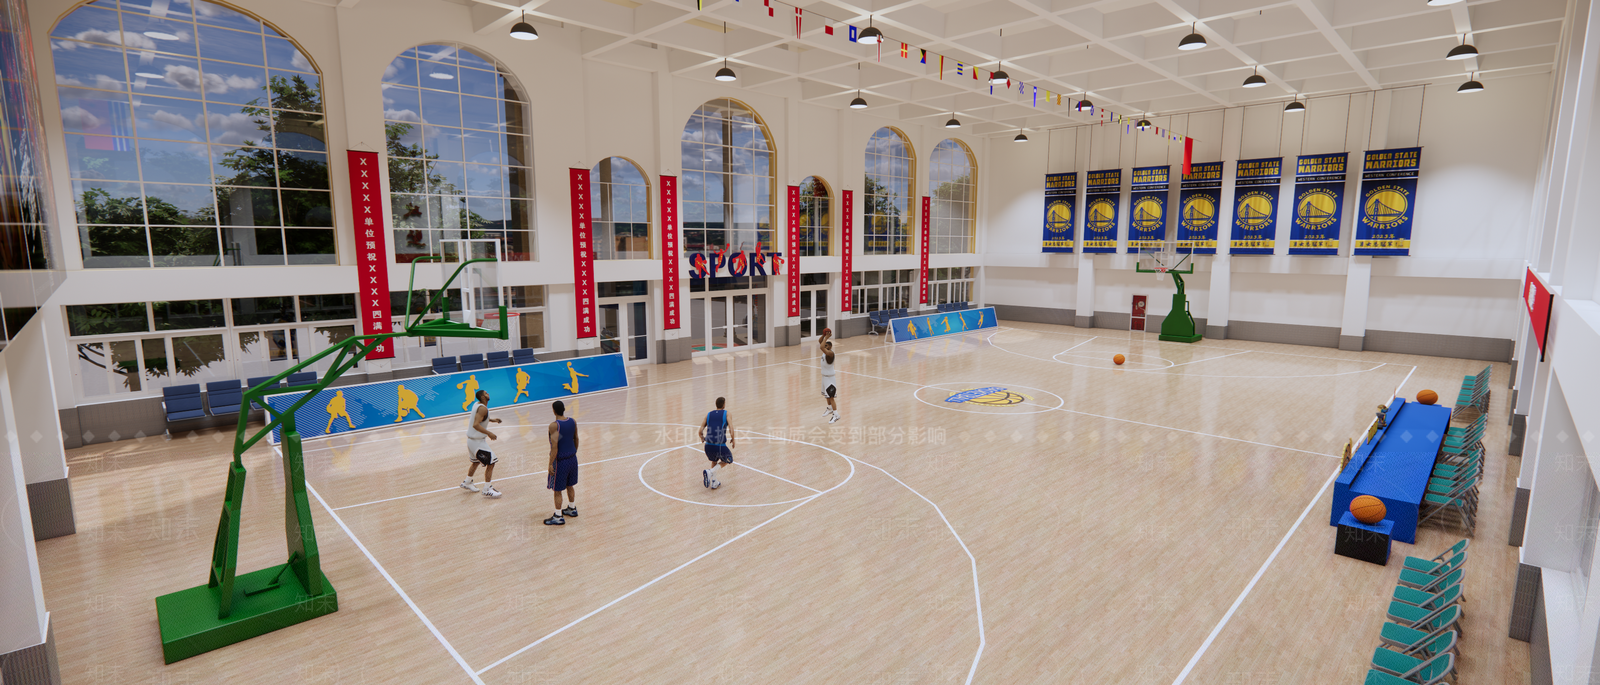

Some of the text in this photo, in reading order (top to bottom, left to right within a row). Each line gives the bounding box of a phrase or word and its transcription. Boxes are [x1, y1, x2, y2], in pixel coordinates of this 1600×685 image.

[1298, 164, 1344, 173] WARRIORS
[1366, 159, 1416, 169] WARRIORS
[1238, 168, 1279, 176] WARRIORS
[1133, 175, 1167, 183] WARRIORS
[1298, 188, 1337, 199] GOLDEN STATE
[1366, 185, 1409, 197] GOLDEN STATE
[1296, 218, 1336, 230] WARRIORS
[1362, 216, 1408, 229] WARRIORS
[360, 157, 385, 353] XXXXX单位预祝XXXX圆满功
[688, 252, 782, 278] SPORT
